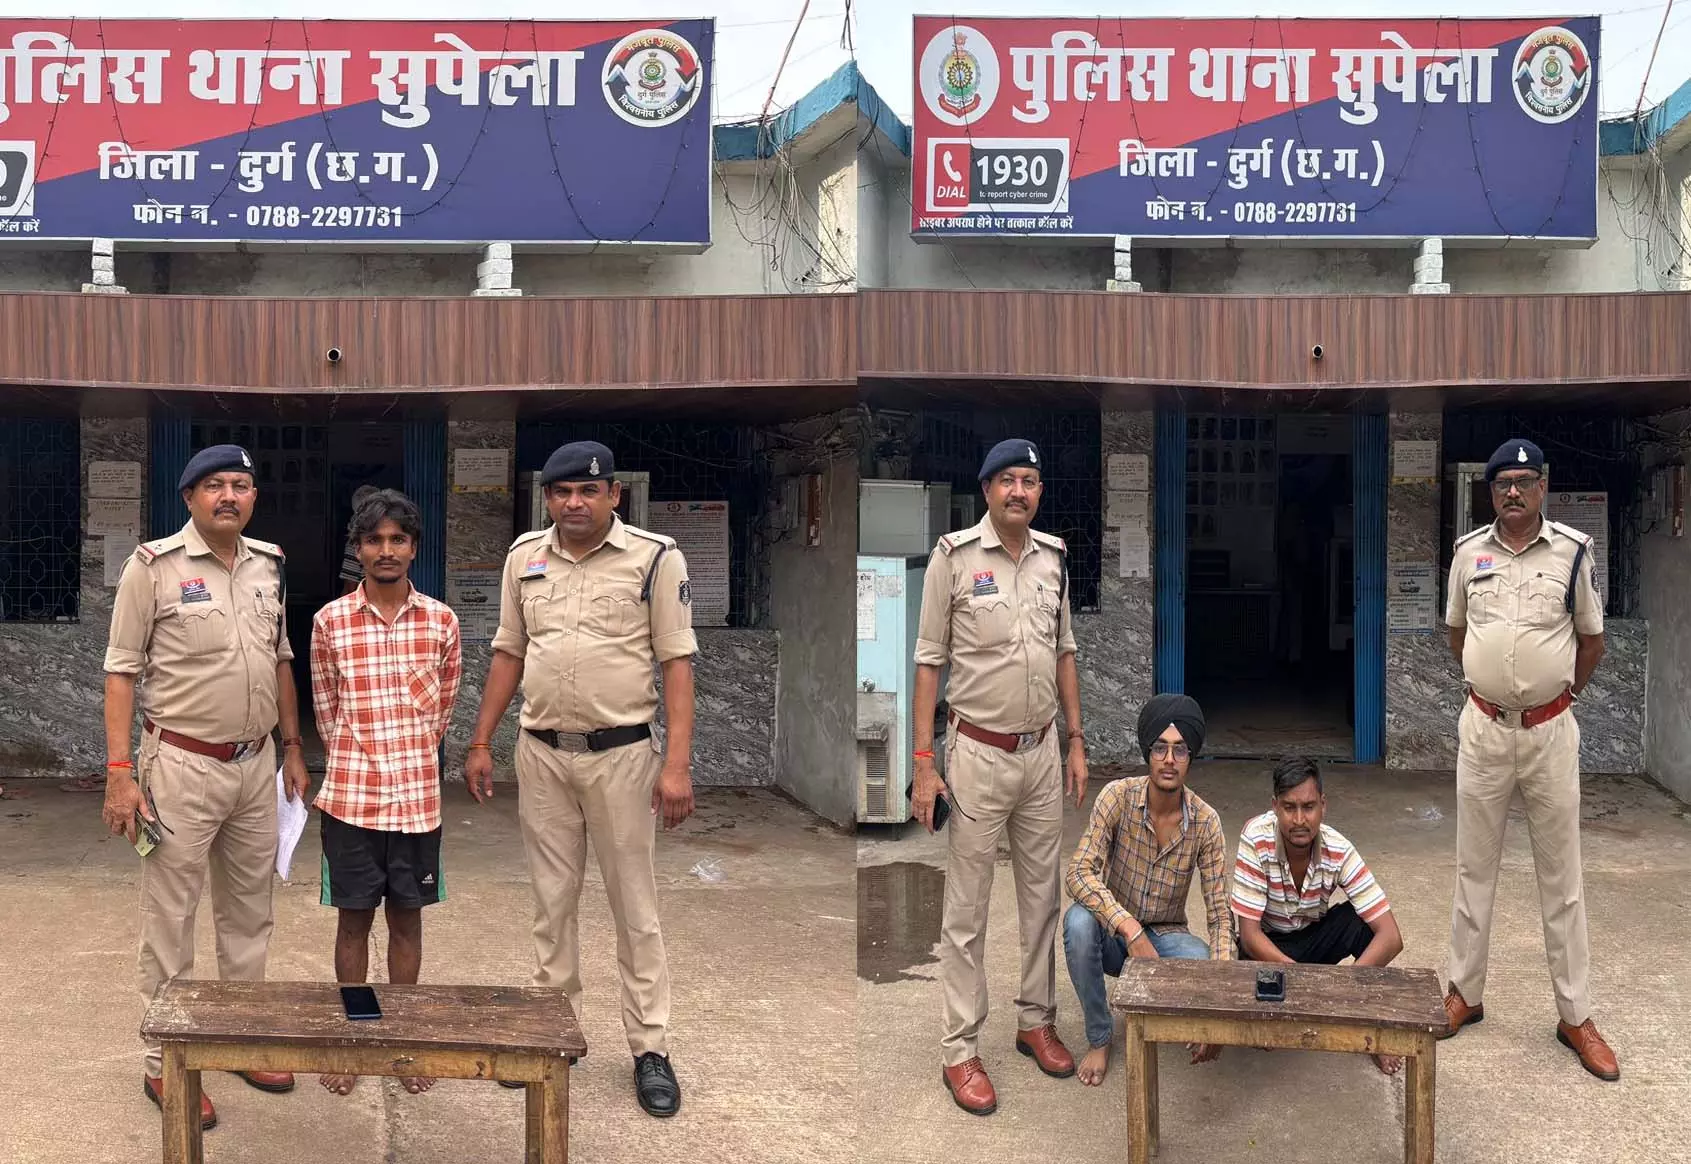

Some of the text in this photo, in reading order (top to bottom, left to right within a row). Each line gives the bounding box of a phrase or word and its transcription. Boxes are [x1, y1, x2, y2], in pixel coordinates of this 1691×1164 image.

[0, 31, 585, 128] लिस थाना सुपेला
[1009, 30, 1499, 126] पुलिस थाना सुपेला
[98, 142, 199, 180] जिला
[238, 141, 296, 193] दुर्ग
[306, 142, 439, 191] (छ.ग.)
[976, 154, 1048, 187] 1930
[1118, 138, 1198, 177] जिला
[1228, 138, 1274, 189] दुर्ग
[1281, 139, 1385, 187] (छ.ग.)
[936, 185, 966, 198] DIAL
[987, 191, 1008, 199] report
[1009, 191, 1028, 199] cyber
[1029, 190, 1048, 198] crime
[133, 198, 185, 224] फोन
[246, 205, 402, 228] 0788-2297731
[946, 217, 975, 228] अपराध
[977, 215, 993, 229] होने
[1146, 195, 1186, 221] फोन
[1234, 201, 1356, 223] 0788-2297731
[22, 218, 40, 232] करें
